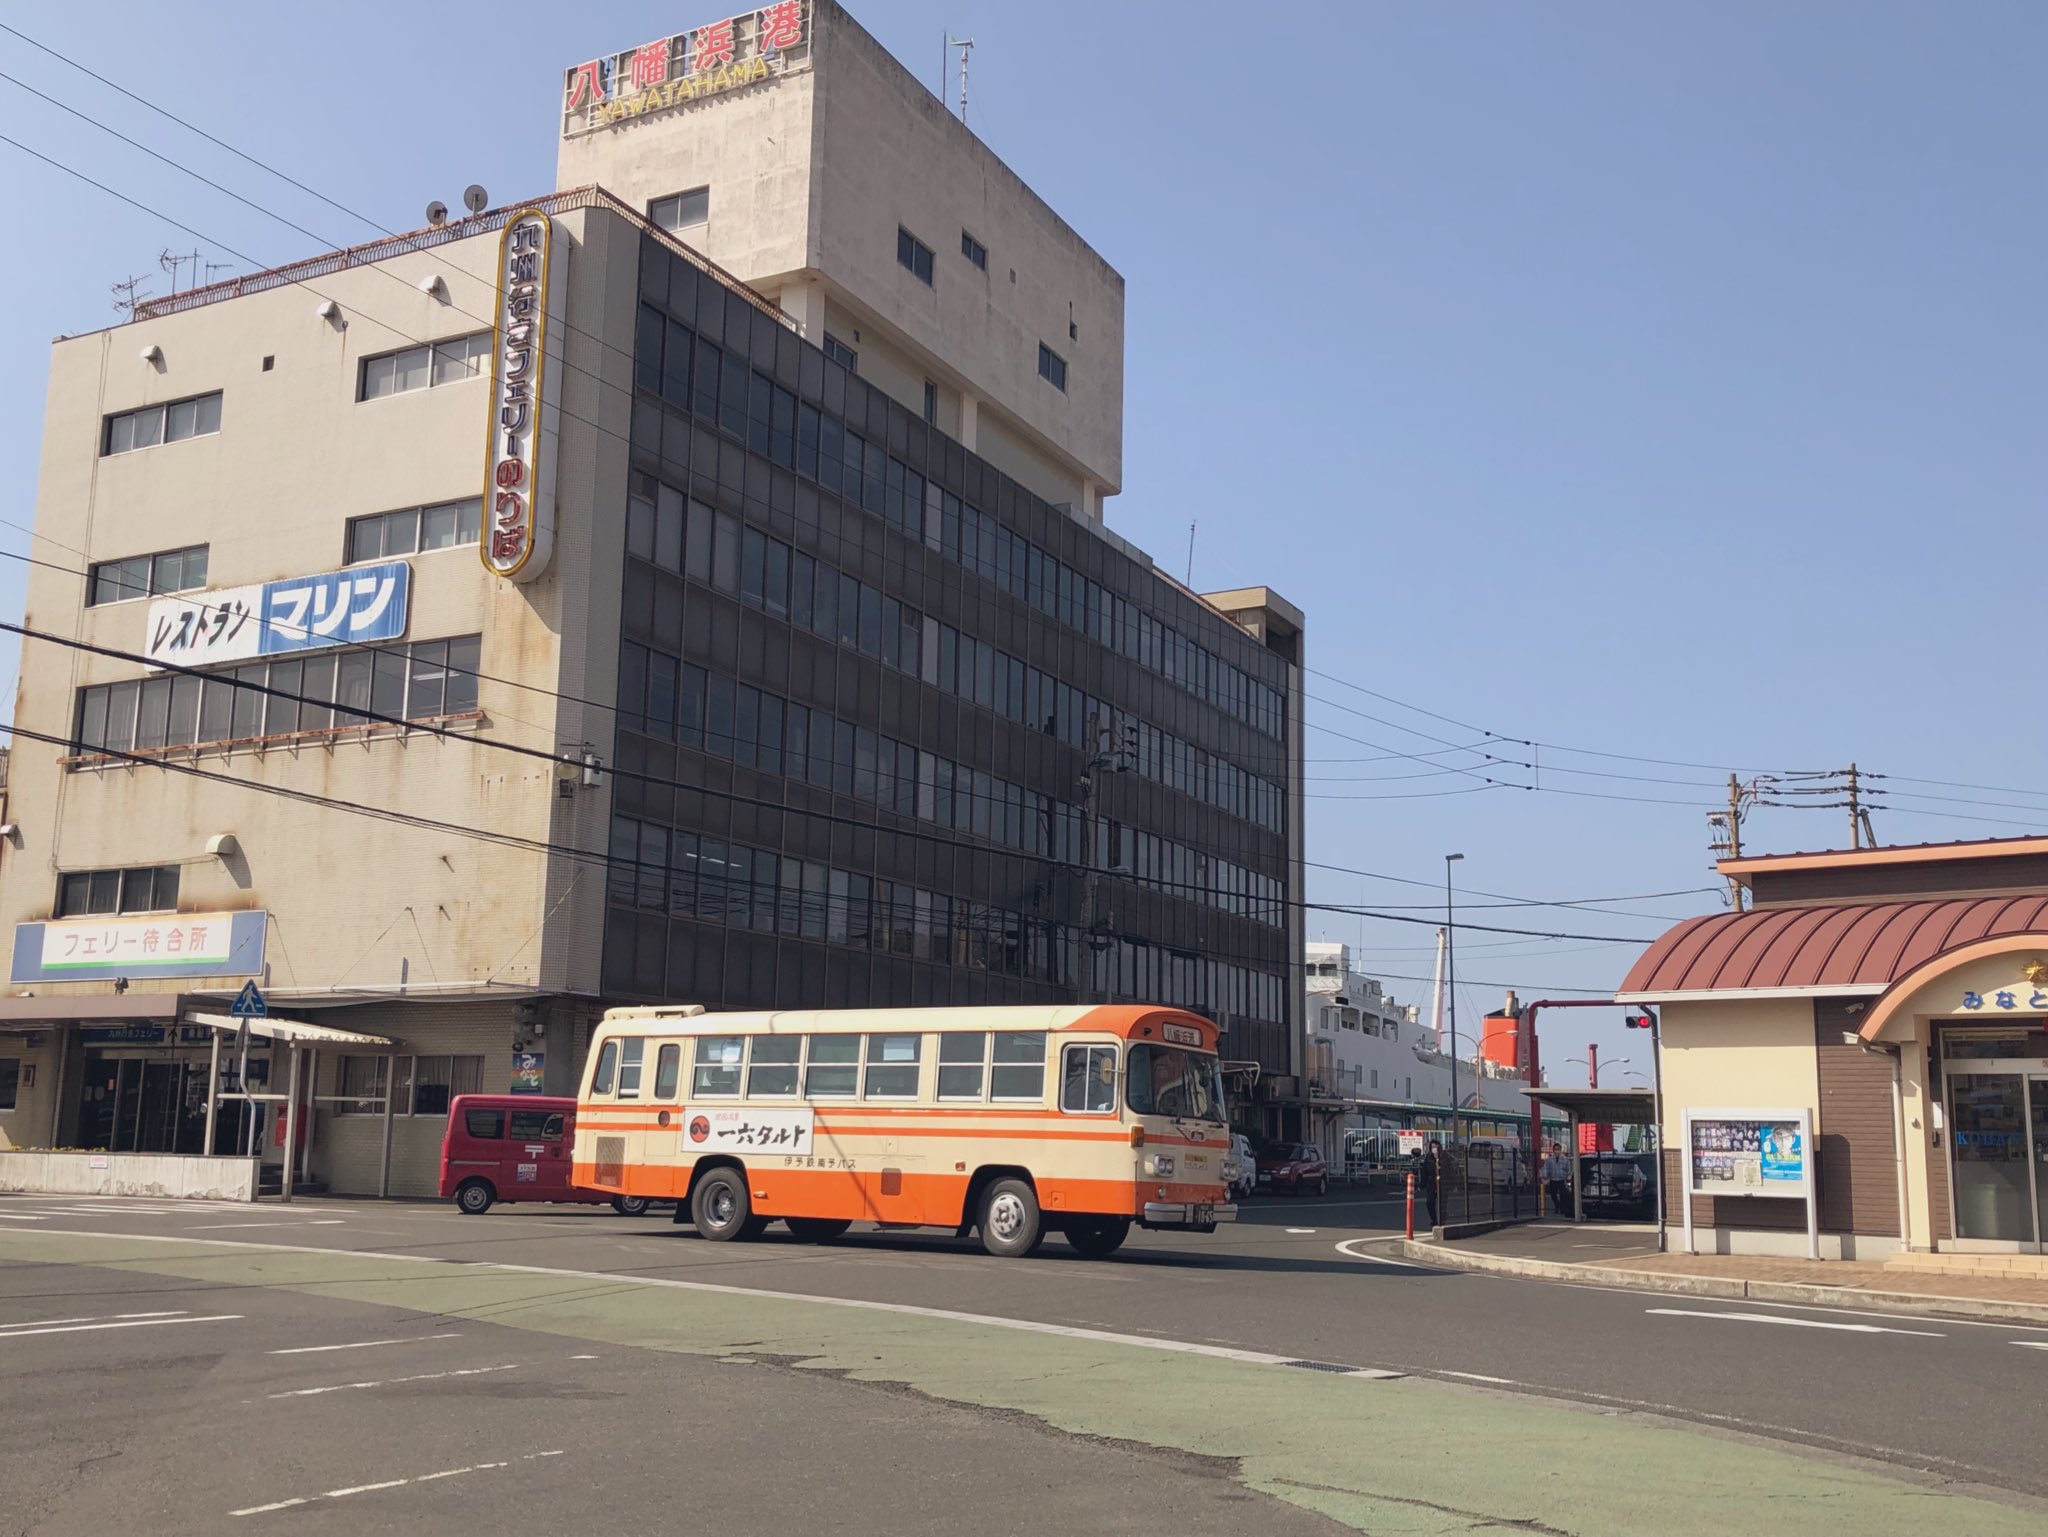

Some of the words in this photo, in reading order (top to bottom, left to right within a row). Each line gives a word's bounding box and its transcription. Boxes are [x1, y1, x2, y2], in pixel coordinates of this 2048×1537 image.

[568, 0, 801, 109] 八幡浜港
[598, 57, 769, 123] YAWATAHAMA
[151, 599, 251, 656] レストラン
[269, 577, 396, 640] マリン
[64, 926, 208, 957] フェリー待合所
[717, 1122, 806, 1148] 一六タルト
[784, 1156, 857, 1169] 伊予鉄南予バス
